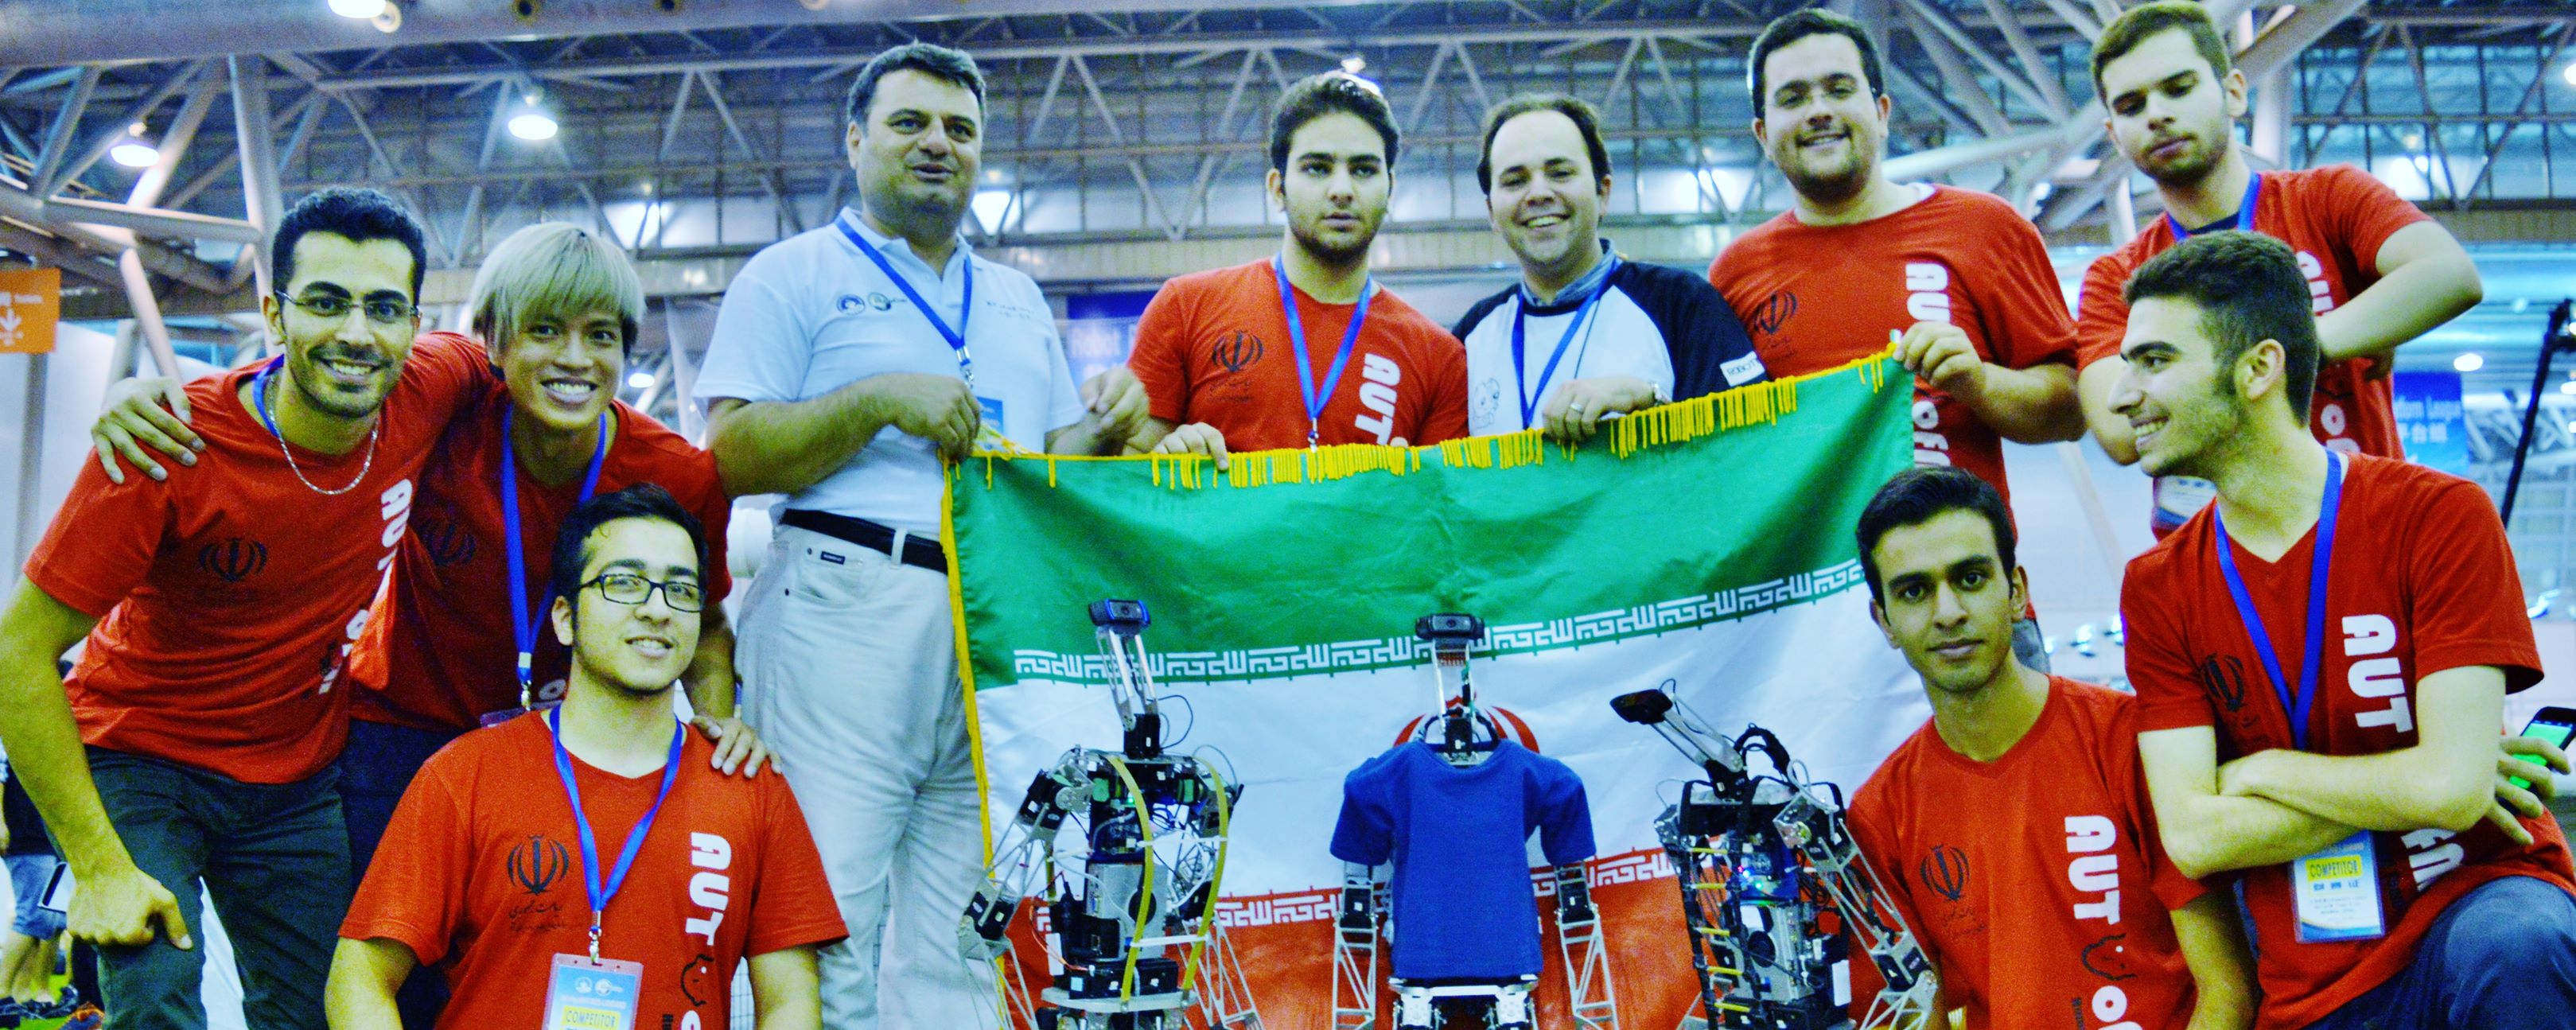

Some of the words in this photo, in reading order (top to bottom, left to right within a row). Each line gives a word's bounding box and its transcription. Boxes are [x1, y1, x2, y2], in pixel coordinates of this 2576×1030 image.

[1355, 352, 1401, 445] AUT
[2341, 613, 2414, 733] AUT
[684, 831, 732, 946] AUT
[2064, 814, 2121, 925] AUT
[2309, 859, 2359, 878] COMPETITOR
[565, 1009, 617, 1028] COMPETITOR
